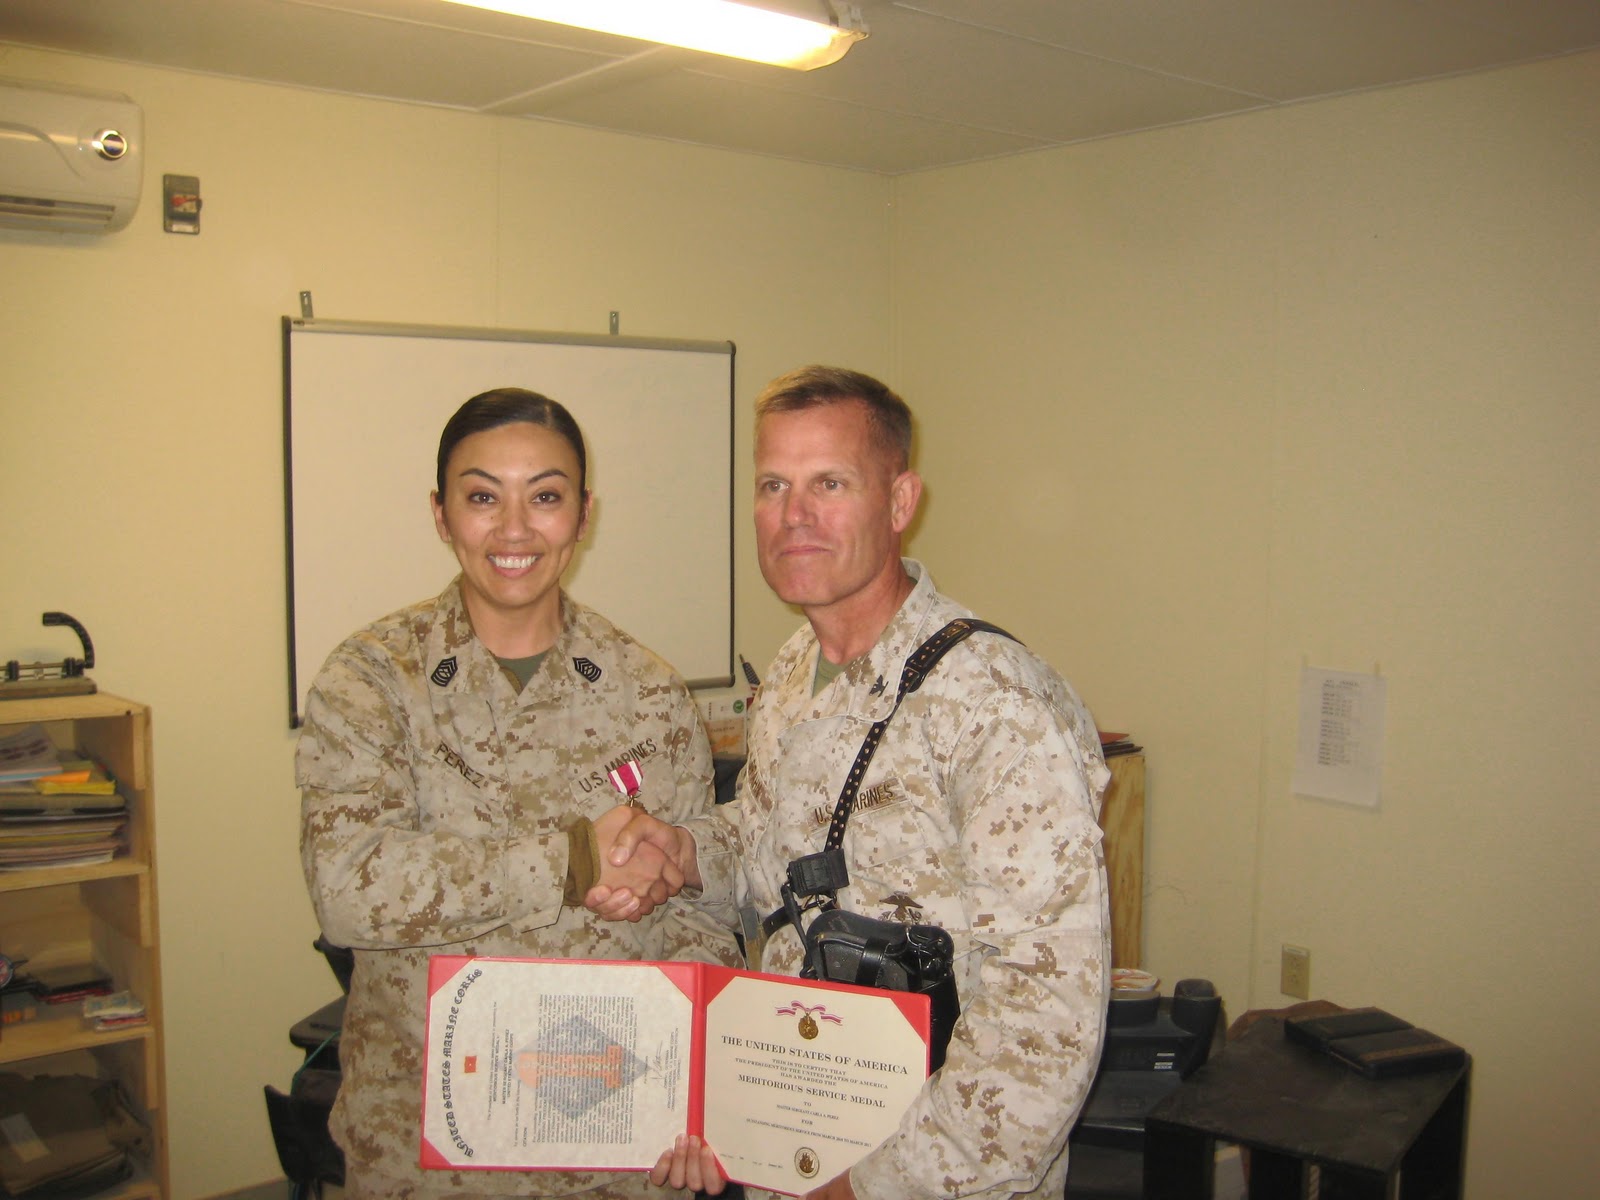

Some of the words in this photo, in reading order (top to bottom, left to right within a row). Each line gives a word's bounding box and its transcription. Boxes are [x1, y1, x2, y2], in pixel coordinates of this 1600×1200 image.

[434, 740, 486, 789] PEREZ
[578, 772, 608, 793] U.S.
[604, 738, 656, 773] MARINES
[850, 783, 894, 814] ARINES
[454, 968, 483, 1005] CORPS
[442, 1006, 459, 1058] MARINE
[722, 1036, 742, 1046] THE
[746, 1040, 786, 1054] UNITED
[789, 1048, 831, 1062] STATES
[835, 1056, 851, 1065] OF
[854, 1059, 908, 1074] AMERICA
[803, 1063, 828, 1072] CERTIFY
[441, 1060, 452, 1109] STATES
[738, 1074, 804, 1093] MERITORIOUS
[806, 1087, 847, 1101] SERVICE
[850, 1095, 886, 1108] MEDAL
[748, 1060, 780, 1069] PRESIDENT
[802, 1069, 824, 1078] UNITED
[859, 1080, 888, 1089] AMERICA
[794, 1074, 823, 1084] AWARDED
[445, 1112, 474, 1158] UNITED
